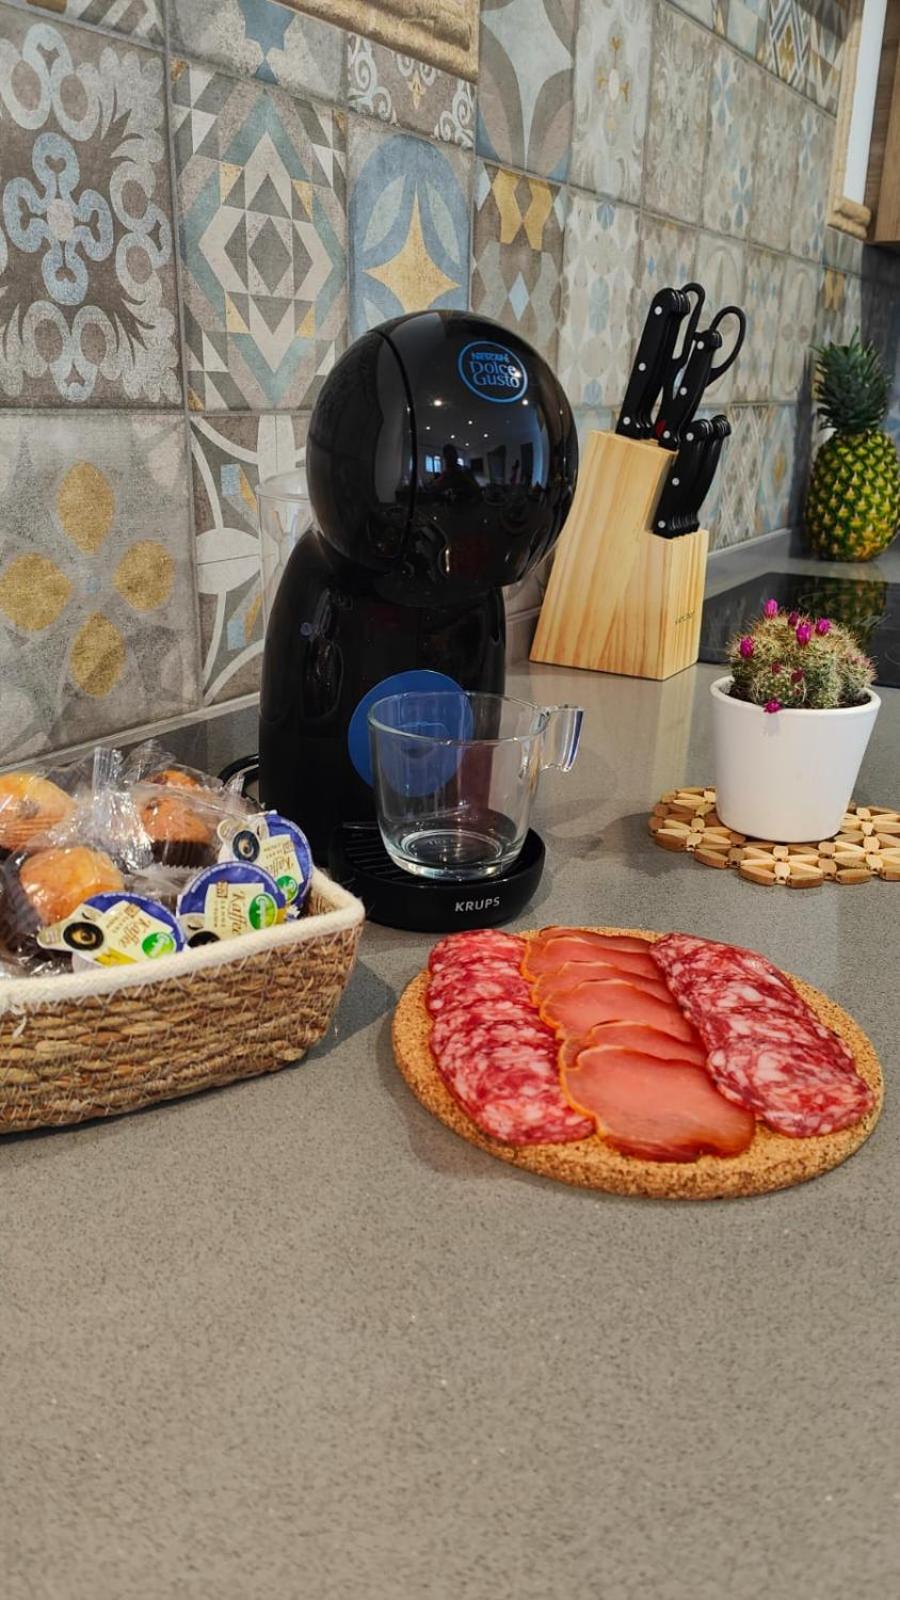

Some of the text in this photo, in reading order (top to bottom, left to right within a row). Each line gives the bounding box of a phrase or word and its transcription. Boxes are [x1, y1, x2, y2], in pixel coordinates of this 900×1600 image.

[470, 361, 516, 377] Dolce
[473, 373, 520, 388] Gusto
[455, 896, 500, 912] KRUPS
